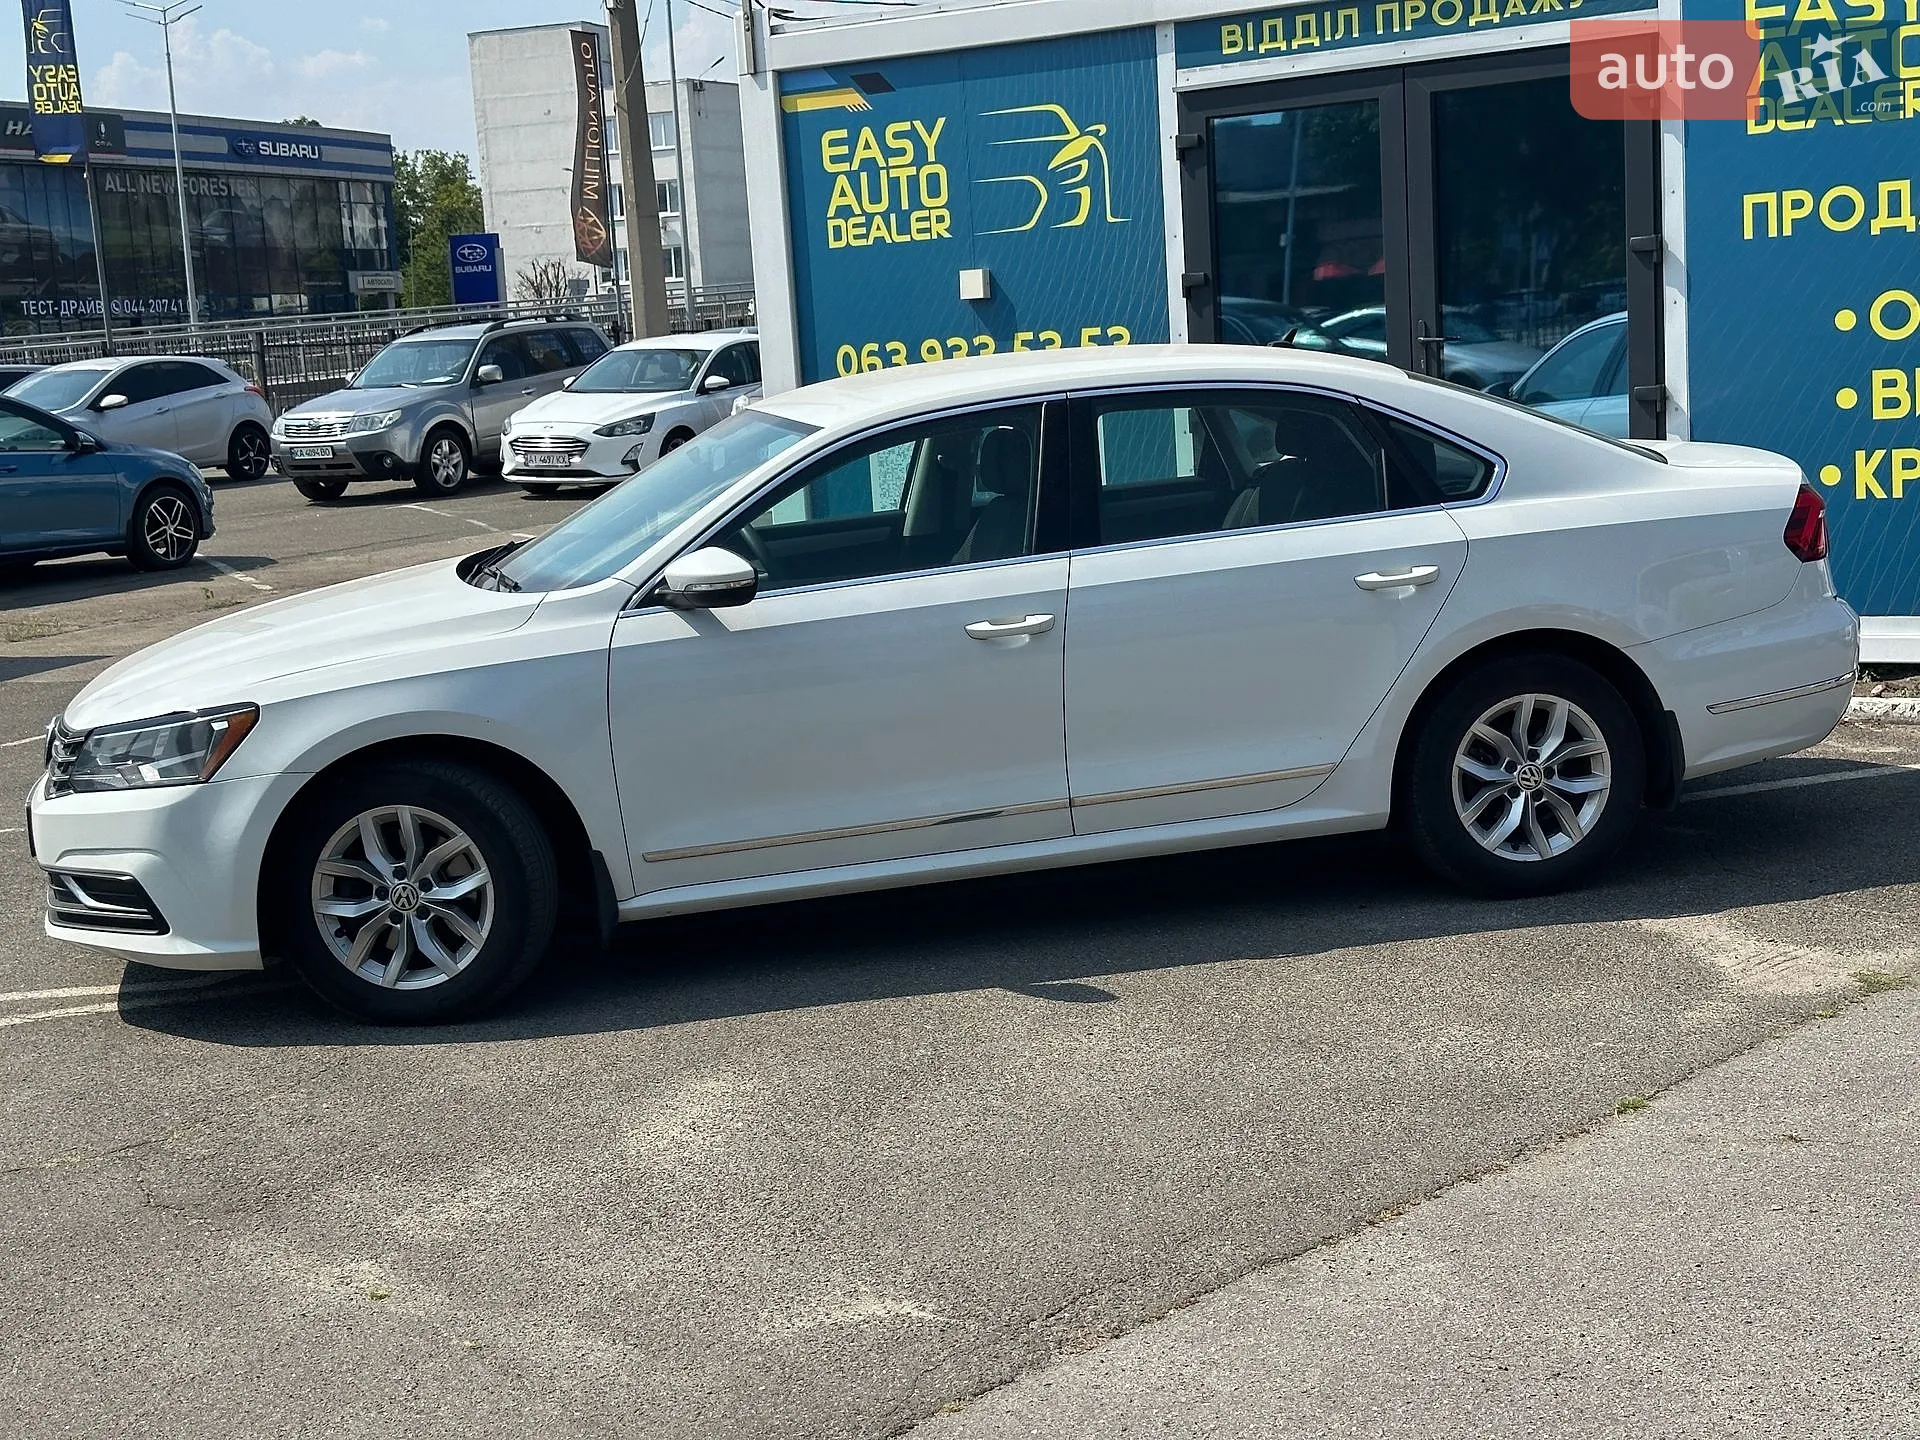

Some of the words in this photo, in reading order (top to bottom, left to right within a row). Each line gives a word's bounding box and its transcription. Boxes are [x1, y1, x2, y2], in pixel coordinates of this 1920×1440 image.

[1221, 8, 1360, 55] ВІДДІЛ
[1376, 0, 1582, 35] ПРОДА
[259, 141, 319, 159] SUBARU
[820, 116, 946, 173] EASY
[105, 173, 136, 193] ALL
[140, 174, 175, 195] NEW
[827, 164, 950, 217] AUTO
[1743, 179, 1920, 239] ПРОД
[827, 208, 952, 249] DEALER
[455, 265, 491, 274] SUBARU
[21, 297, 104, 316] ТЕСТ-ДРАЙВ
[125, 299, 145, 313] 044
[150, 299, 168, 312] 207
[171, 299, 184, 312] 41
[836, 342, 907, 378] 063
